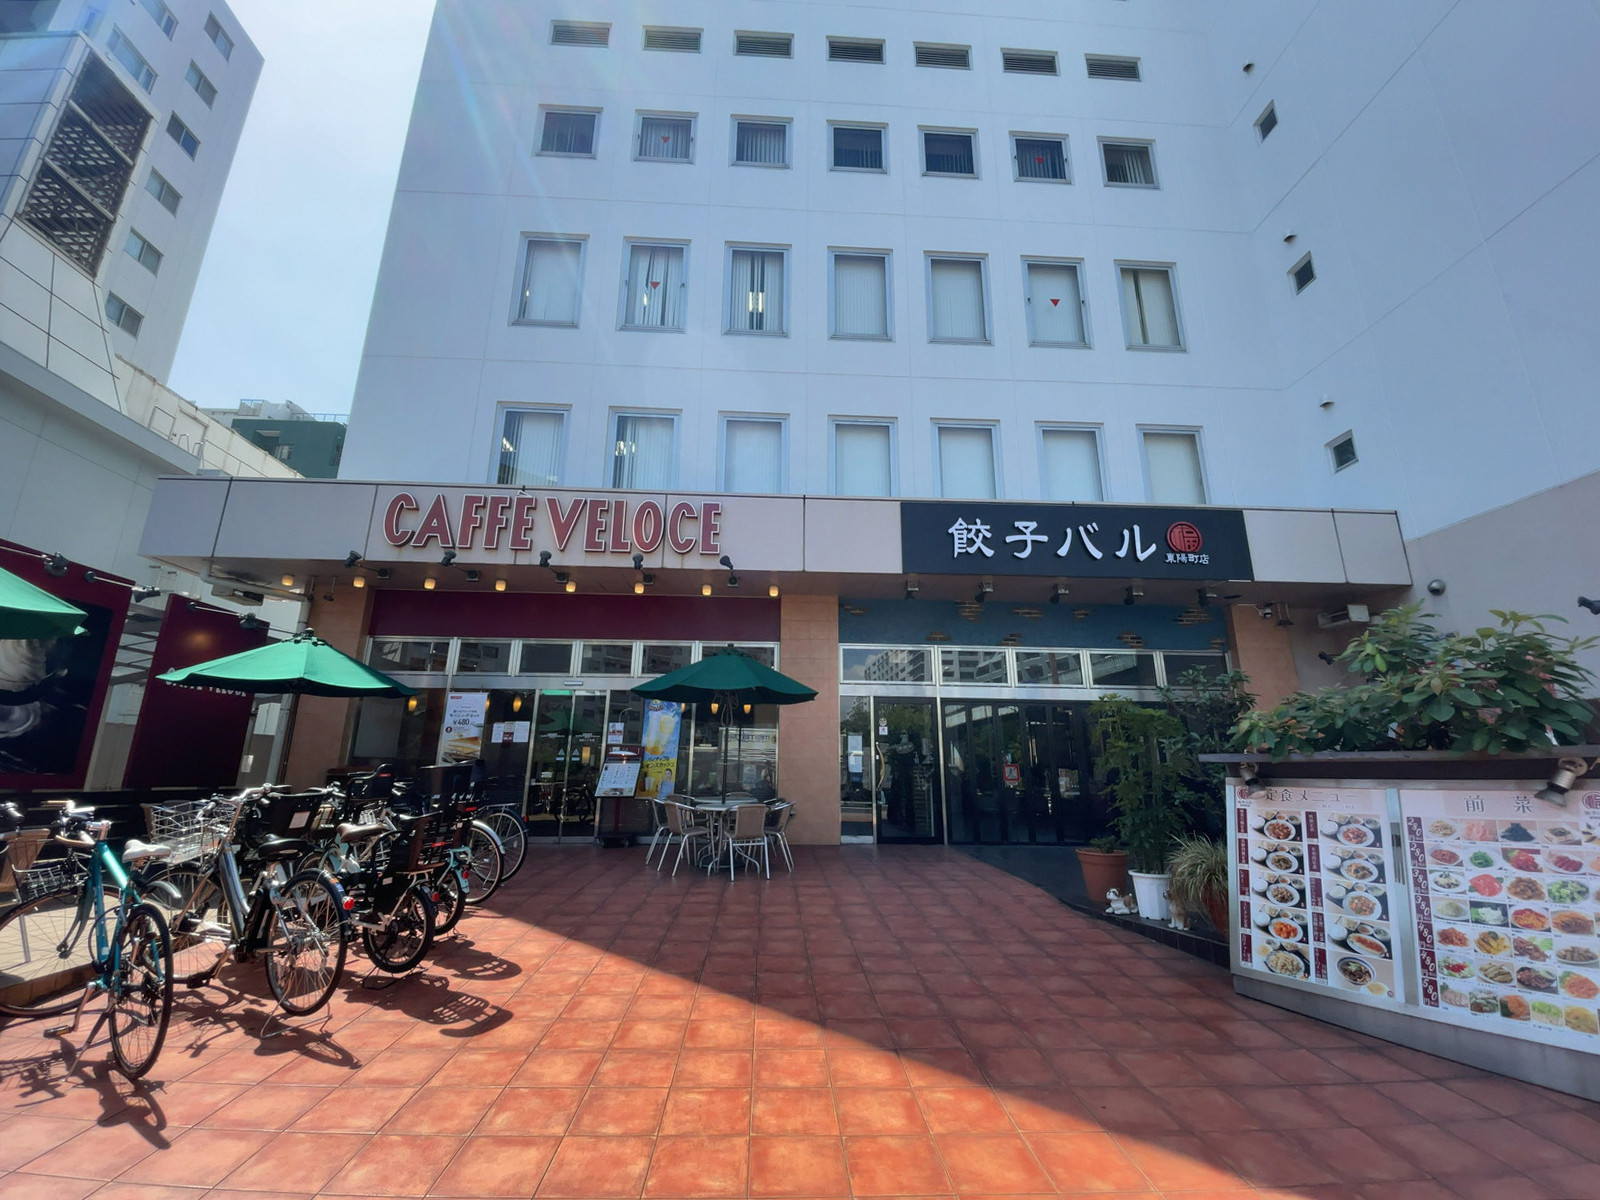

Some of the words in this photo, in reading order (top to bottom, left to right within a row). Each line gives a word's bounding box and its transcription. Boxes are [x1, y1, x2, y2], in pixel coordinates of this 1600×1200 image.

[383, 490, 537, 549] CAFFÈ
[546, 497, 723, 555] VELOCE
[948, 517, 1157, 563] 餃子バル
[1165, 553, 1210, 565] 東陽町店
